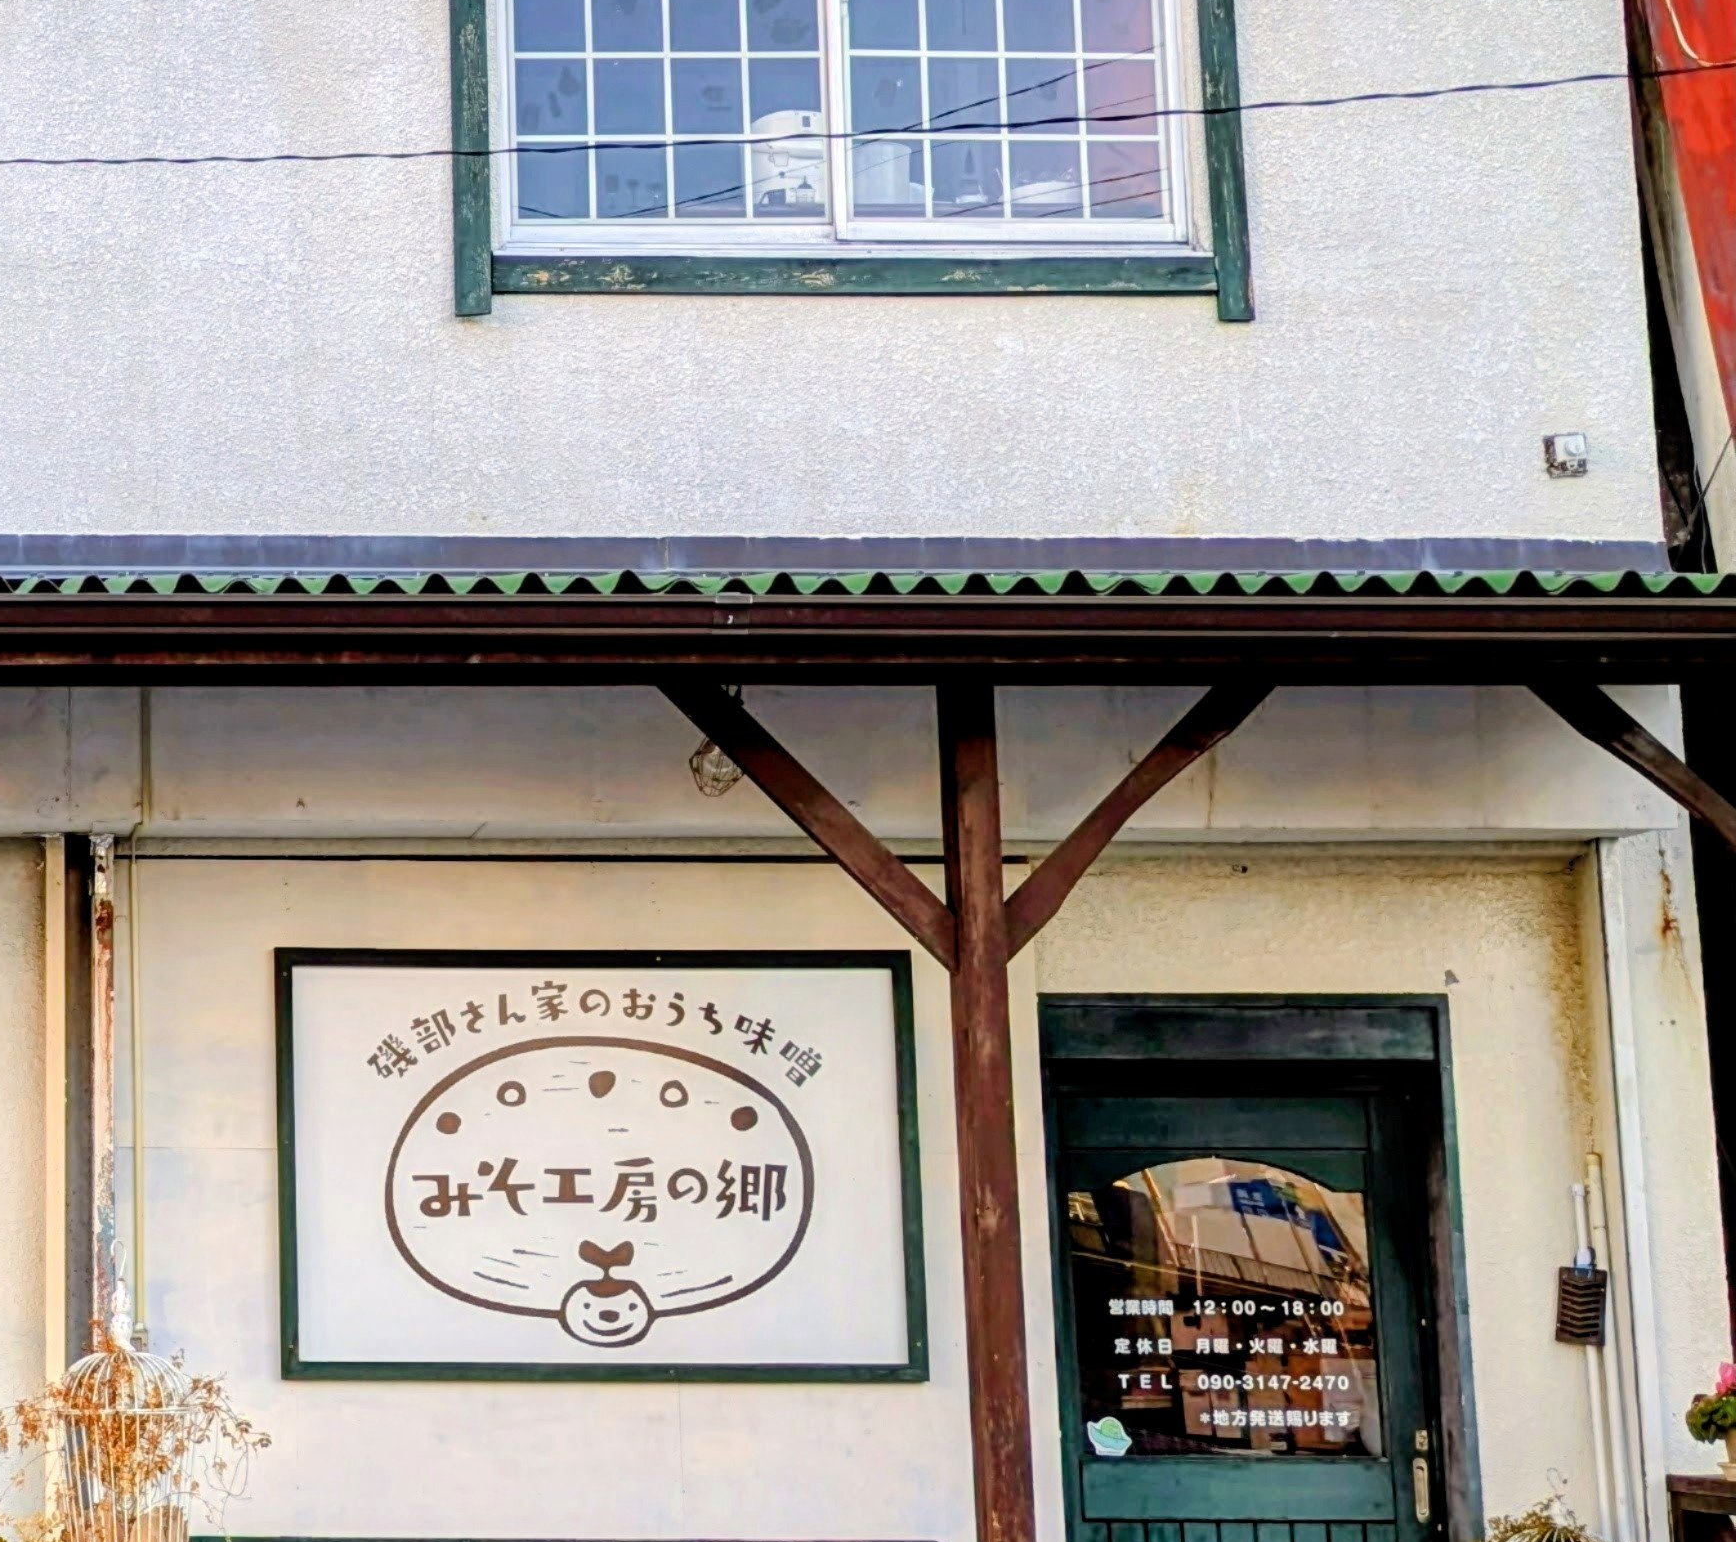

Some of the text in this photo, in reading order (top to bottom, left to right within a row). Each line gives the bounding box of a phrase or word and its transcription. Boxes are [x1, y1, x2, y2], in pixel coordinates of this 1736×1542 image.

[367, 979, 824, 1088] 磯部さん家のおうち味噌
[412, 1156, 789, 1222] みそ工房の郷
[1108, 1299, 1174, 1316] 営業時間
[1114, 1338, 1339, 1355] 定休日 月曜・火曜・水曜
[1117, 1374, 1350, 1390] TEL 090-3147-2470
